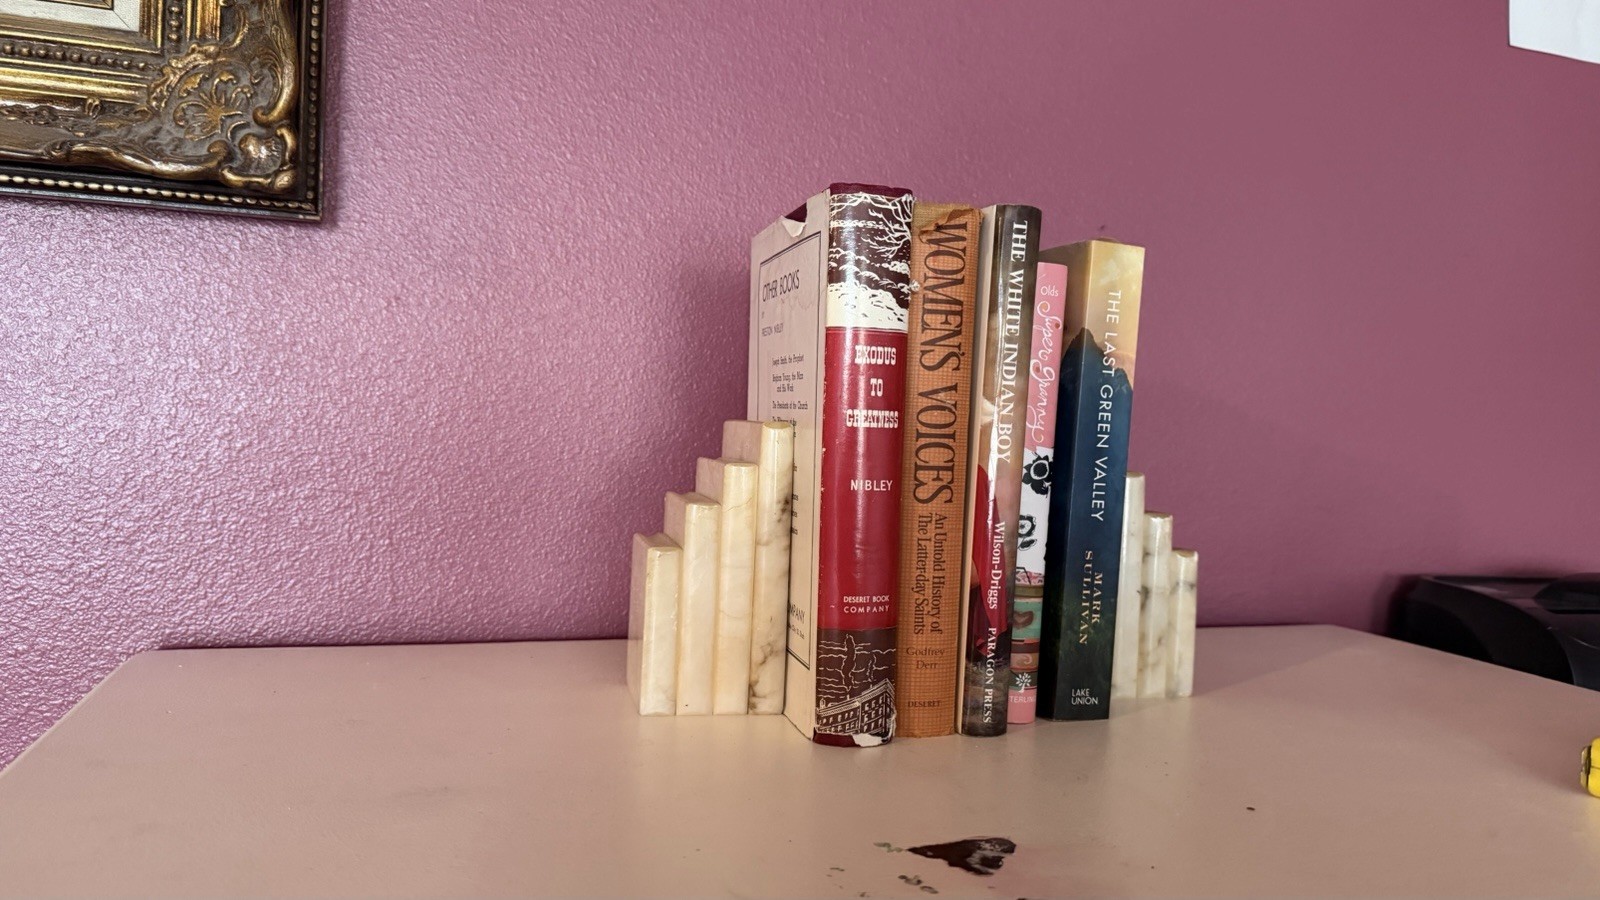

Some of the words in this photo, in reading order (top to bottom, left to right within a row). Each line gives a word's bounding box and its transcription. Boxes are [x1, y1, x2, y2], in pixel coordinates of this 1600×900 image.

[1010, 220, 1028, 262] THE
[762, 280, 778, 302] OTHER
[779, 269, 800, 295] BOOKS
[919, 221, 968, 372] WOMEN'S
[1005, 269, 1025, 337] WHITE
[1040, 285, 1059, 297] Olds
[1106, 290, 1121, 324] THE
[1037, 301, 1062, 361] Super
[854, 345, 897, 366] EXODUS
[1102, 332, 1118, 377] LAST
[870, 378, 884, 397] TO
[998, 342, 1019, 416] INDIAN
[845, 409, 899, 428] GREATNESS
[1026, 359, 1056, 443] Granny
[1096, 384, 1114, 448] GREEN
[913, 382, 959, 504] VOICES
[996, 423, 1013, 464] BOY
[850, 479, 893, 491] NIBLEY
[1091, 456, 1108, 521] VALLEY
[918, 513, 933, 535] The
[935, 512, 948, 530] An
[911, 537, 930, 596] Latter-day
[932, 532, 947, 573] Untold
[987, 521, 1006, 611] Wilson-Driggs
[843, 595, 871, 604] DESERET
[872, 595, 890, 603] BOOK
[843, 604, 890, 614] COMPANY
[927, 575, 946, 618] History
[1078, 550, 1093, 645] SULLIVAN
[1091, 572, 1103, 623] MARK
[913, 598, 929, 635] Saints
[929, 619, 943, 635] of
[906, 646, 946, 657] Godfrey
[916, 660, 939, 670] Derr
[983, 627, 997, 685] PARAGON
[907, 700, 942, 708] DESERET
[982, 688, 994, 724] PRESS
[1071, 688, 1090, 697] LAKE
[1071, 697, 1099, 705] UNION
